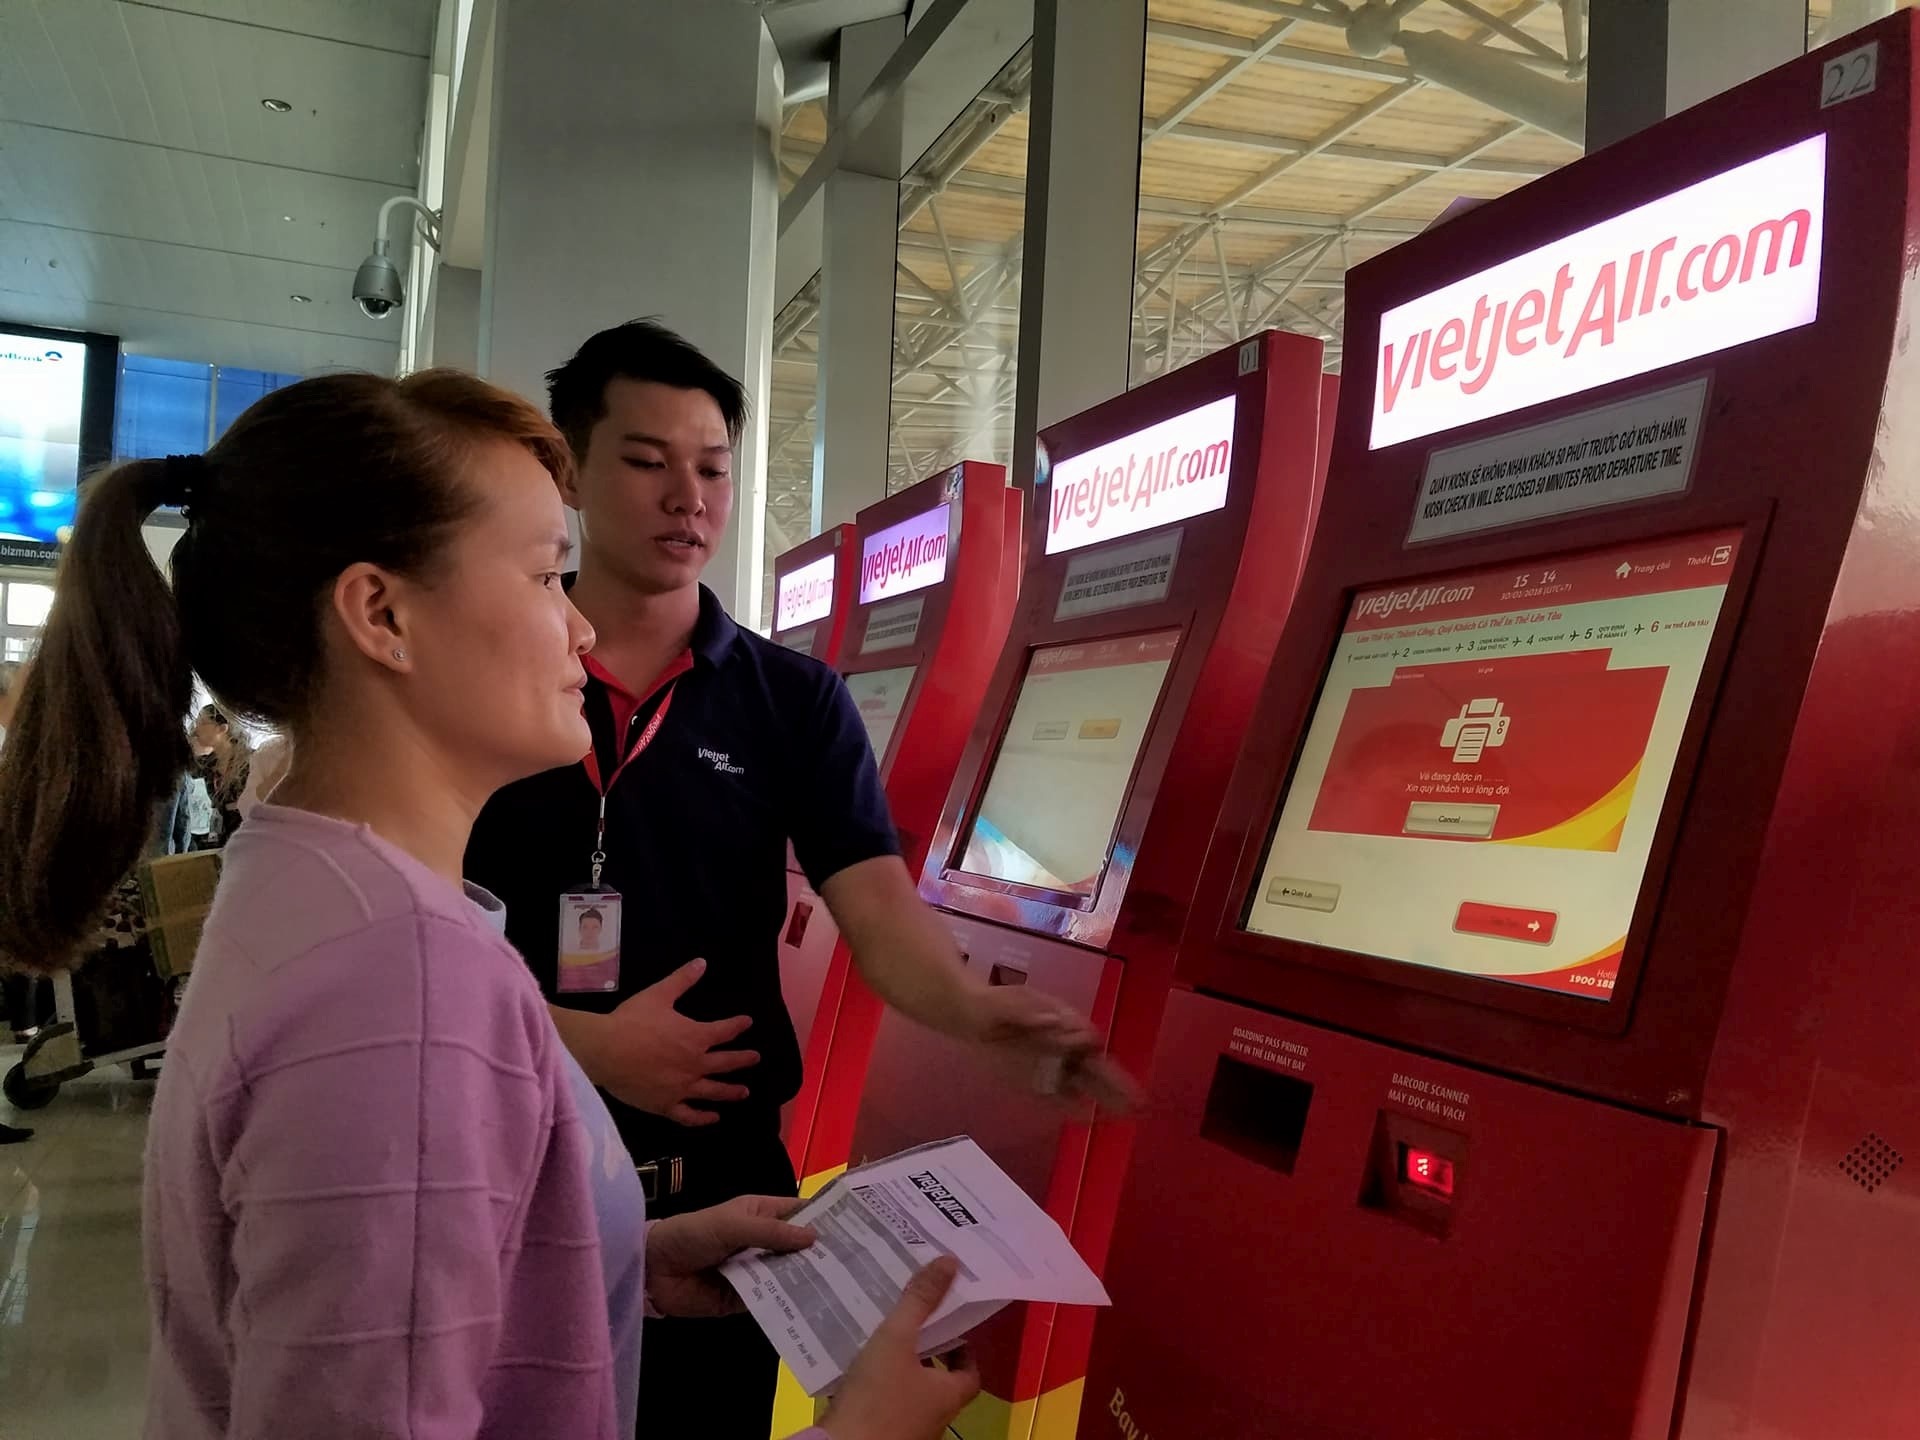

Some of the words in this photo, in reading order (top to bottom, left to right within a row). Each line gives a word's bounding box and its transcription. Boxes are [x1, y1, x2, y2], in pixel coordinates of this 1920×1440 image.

[1824, 54, 1872, 105] 22
[1241, 345, 1257, 372] 01
[1423, 499, 1446, 519] KIOSK
[1444, 494, 1471, 515] CHECK
[1467, 492, 1477, 509] IN
[1477, 488, 1494, 507] WILL
[1493, 485, 1505, 504] BE
[1504, 478, 1536, 501] CLOSED
[1544, 468, 1581, 492] MINUTES
[1580, 462, 1607, 485] PRIOR
[1606, 450, 1660, 479] DEPARTURE
[1448, 471, 1471, 490] KIOSK
[1633, 563, 1656, 575] Trang
[1513, 573, 1530, 588] 15
[1540, 570, 1557, 584] 14
[1651, 620, 1660, 633] 6
[1526, 634, 1534, 645] 4
[1584, 628, 1593, 640] 5
[1467, 640, 1475, 651] 3
[1402, 647, 1410, 658] 2
[1431, 771, 1451, 783] đang
[1452, 771, 1472, 783] được
[1474, 773, 1482, 781] in
[1406, 783, 1419, 793] Xin
[1435, 783, 1460, 793] khách
[1461, 785, 1474, 794] vui
[1475, 784, 1494, 796] lòng
[1438, 815, 1461, 824] Cancel
[1569, 974, 1595, 986] 1900
[1232, 1026, 1265, 1044] BOARDING
[1264, 1035, 1281, 1049] PASS
[1281, 1040, 1310, 1057] PRINTER
[1291, 1059, 1306, 1072] BAY
[1392, 1072, 1430, 1093] BARCODE
[1430, 1083, 1470, 1105] SCANNER
